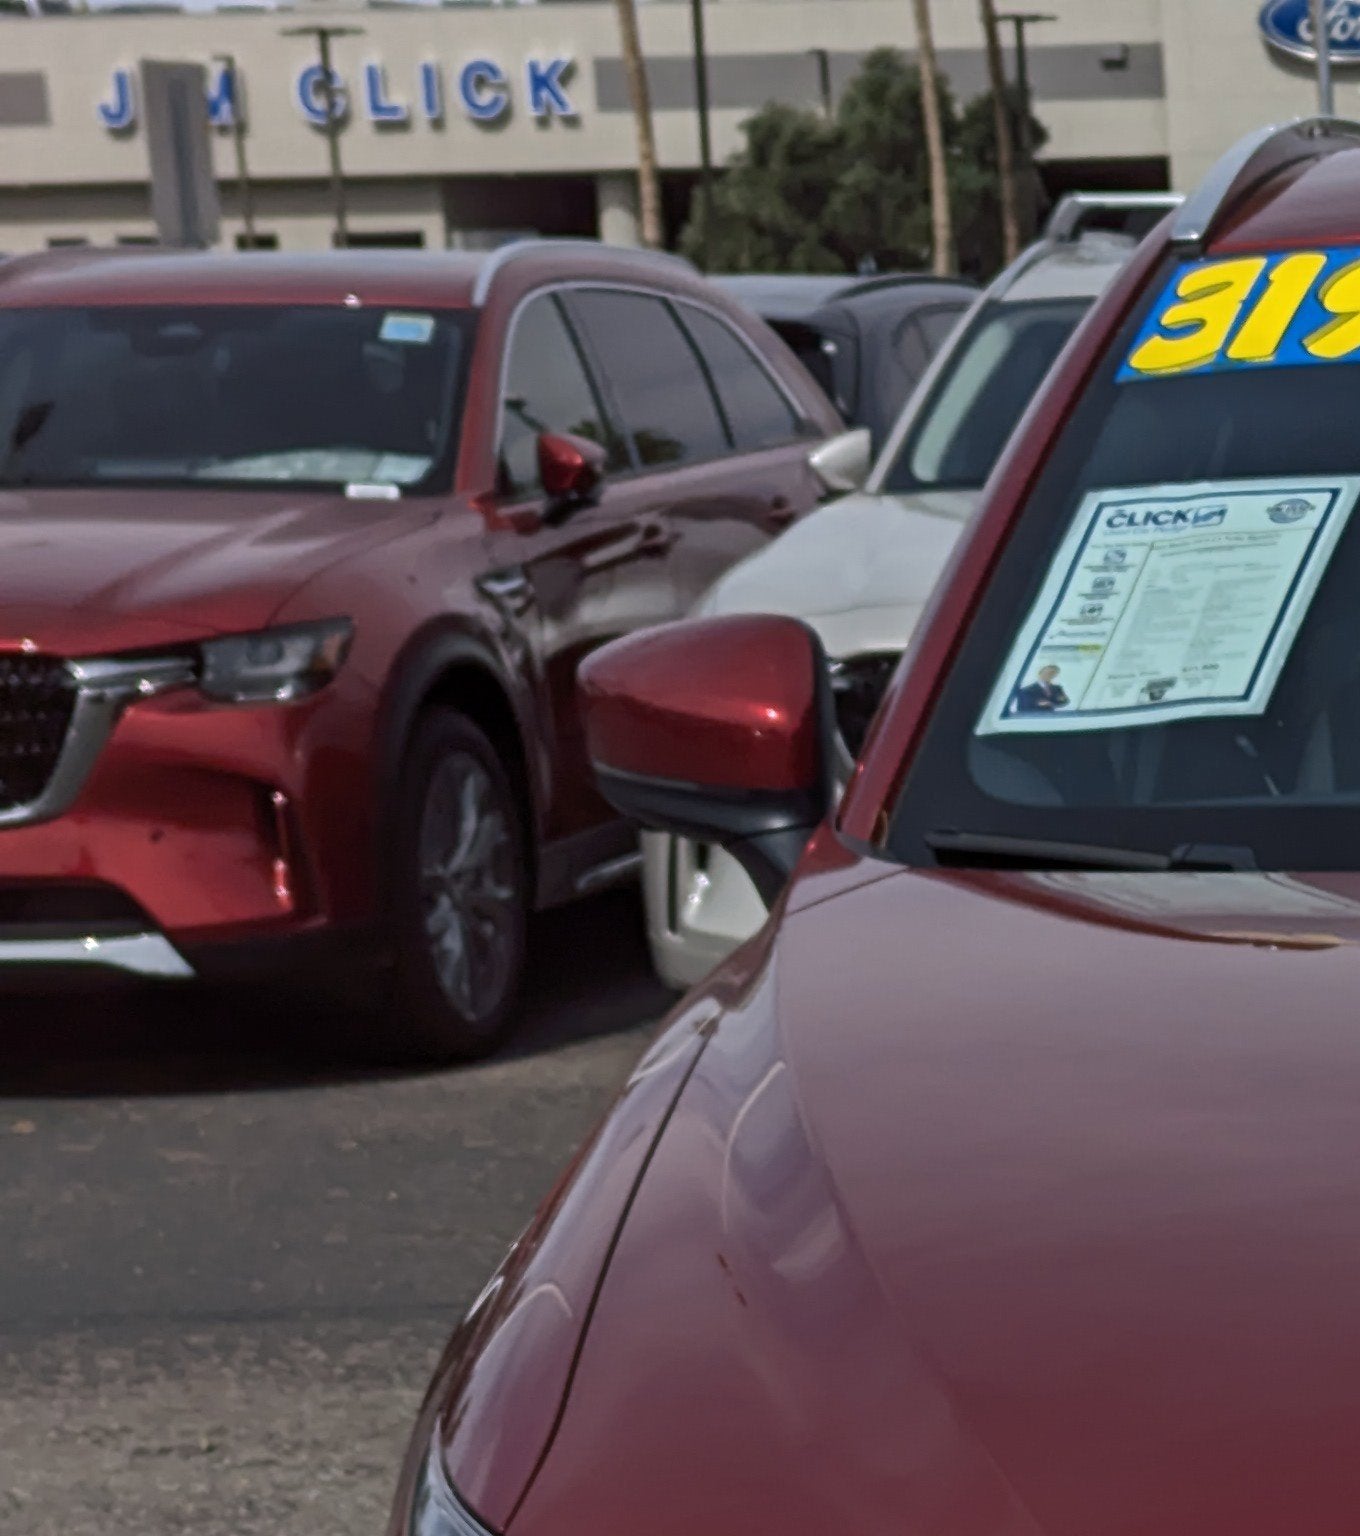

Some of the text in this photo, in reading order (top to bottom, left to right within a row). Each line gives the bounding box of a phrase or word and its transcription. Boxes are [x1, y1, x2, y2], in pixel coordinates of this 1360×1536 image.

[98, 58, 572, 129] JM CLICK
[1106, 509, 1193, 528] CLICK
